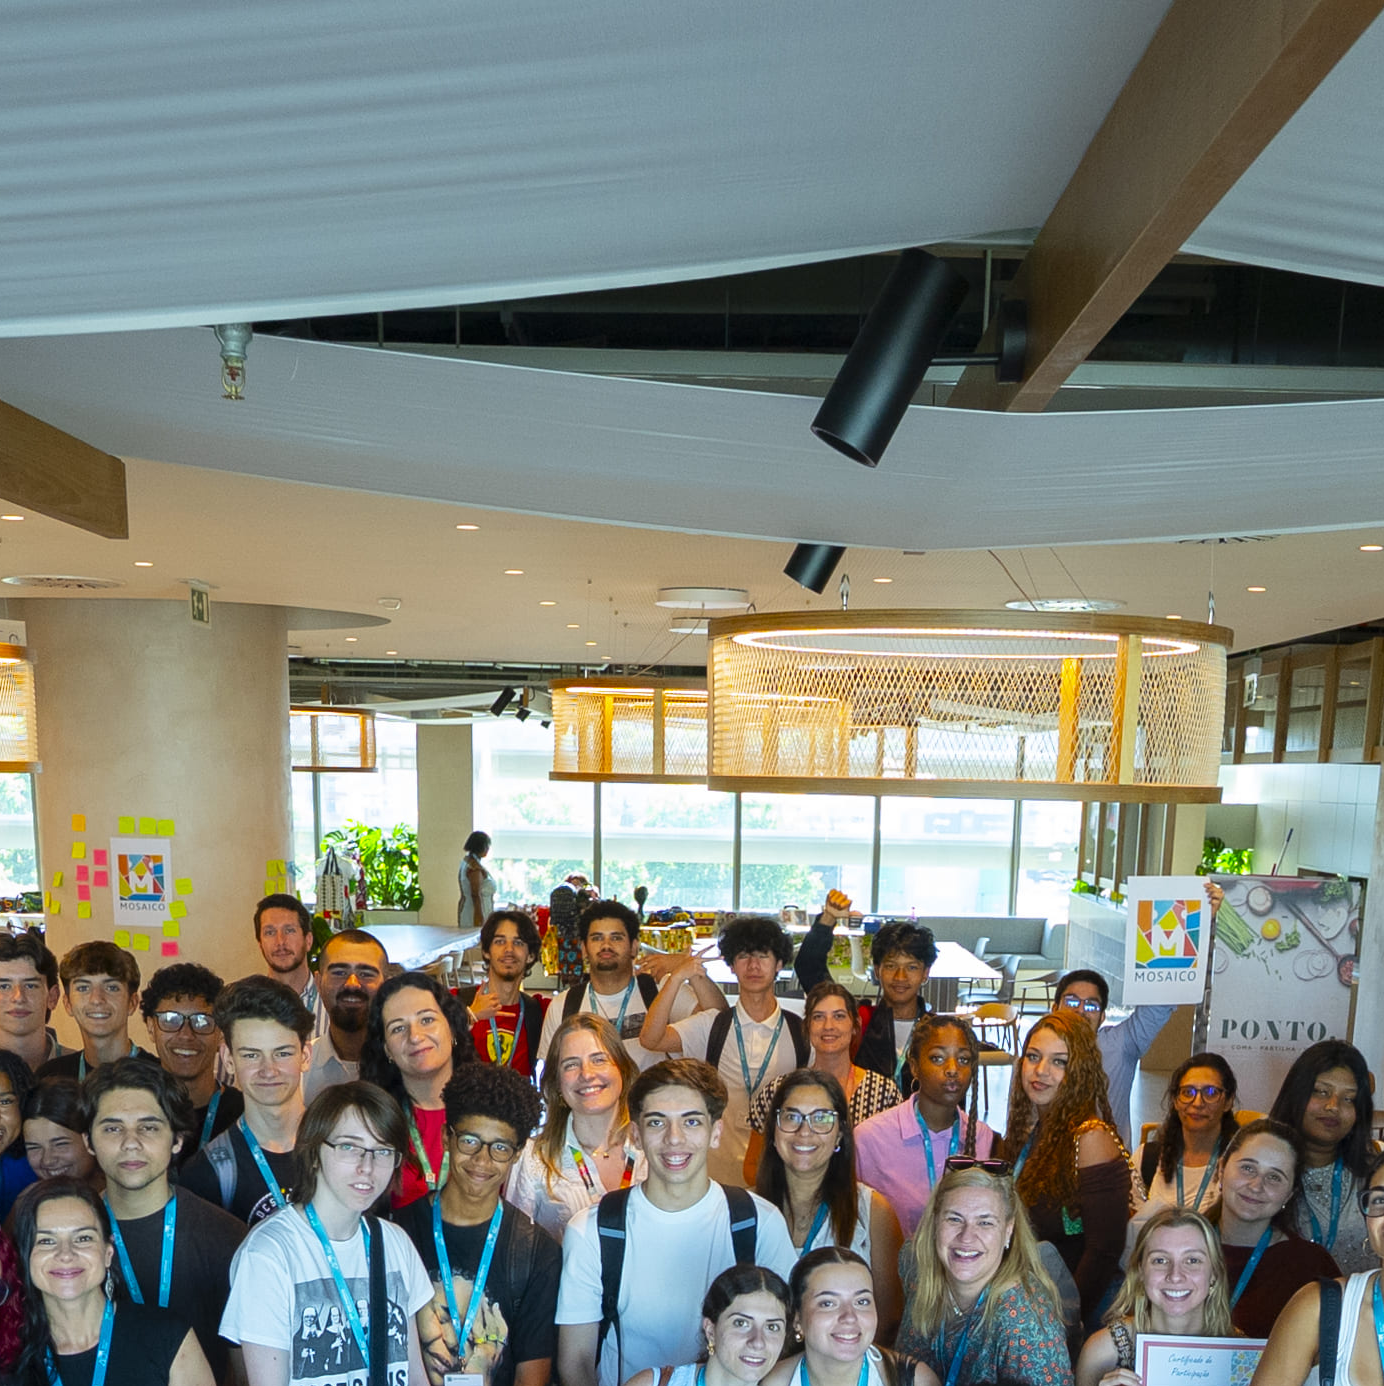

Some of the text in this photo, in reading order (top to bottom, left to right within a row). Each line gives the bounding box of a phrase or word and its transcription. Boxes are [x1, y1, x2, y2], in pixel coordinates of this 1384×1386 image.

[119, 901, 166, 912] MOSAICO
[1134, 969, 1197, 983] MOSAICO
[1221, 1019, 1336, 1042] PONTO.
